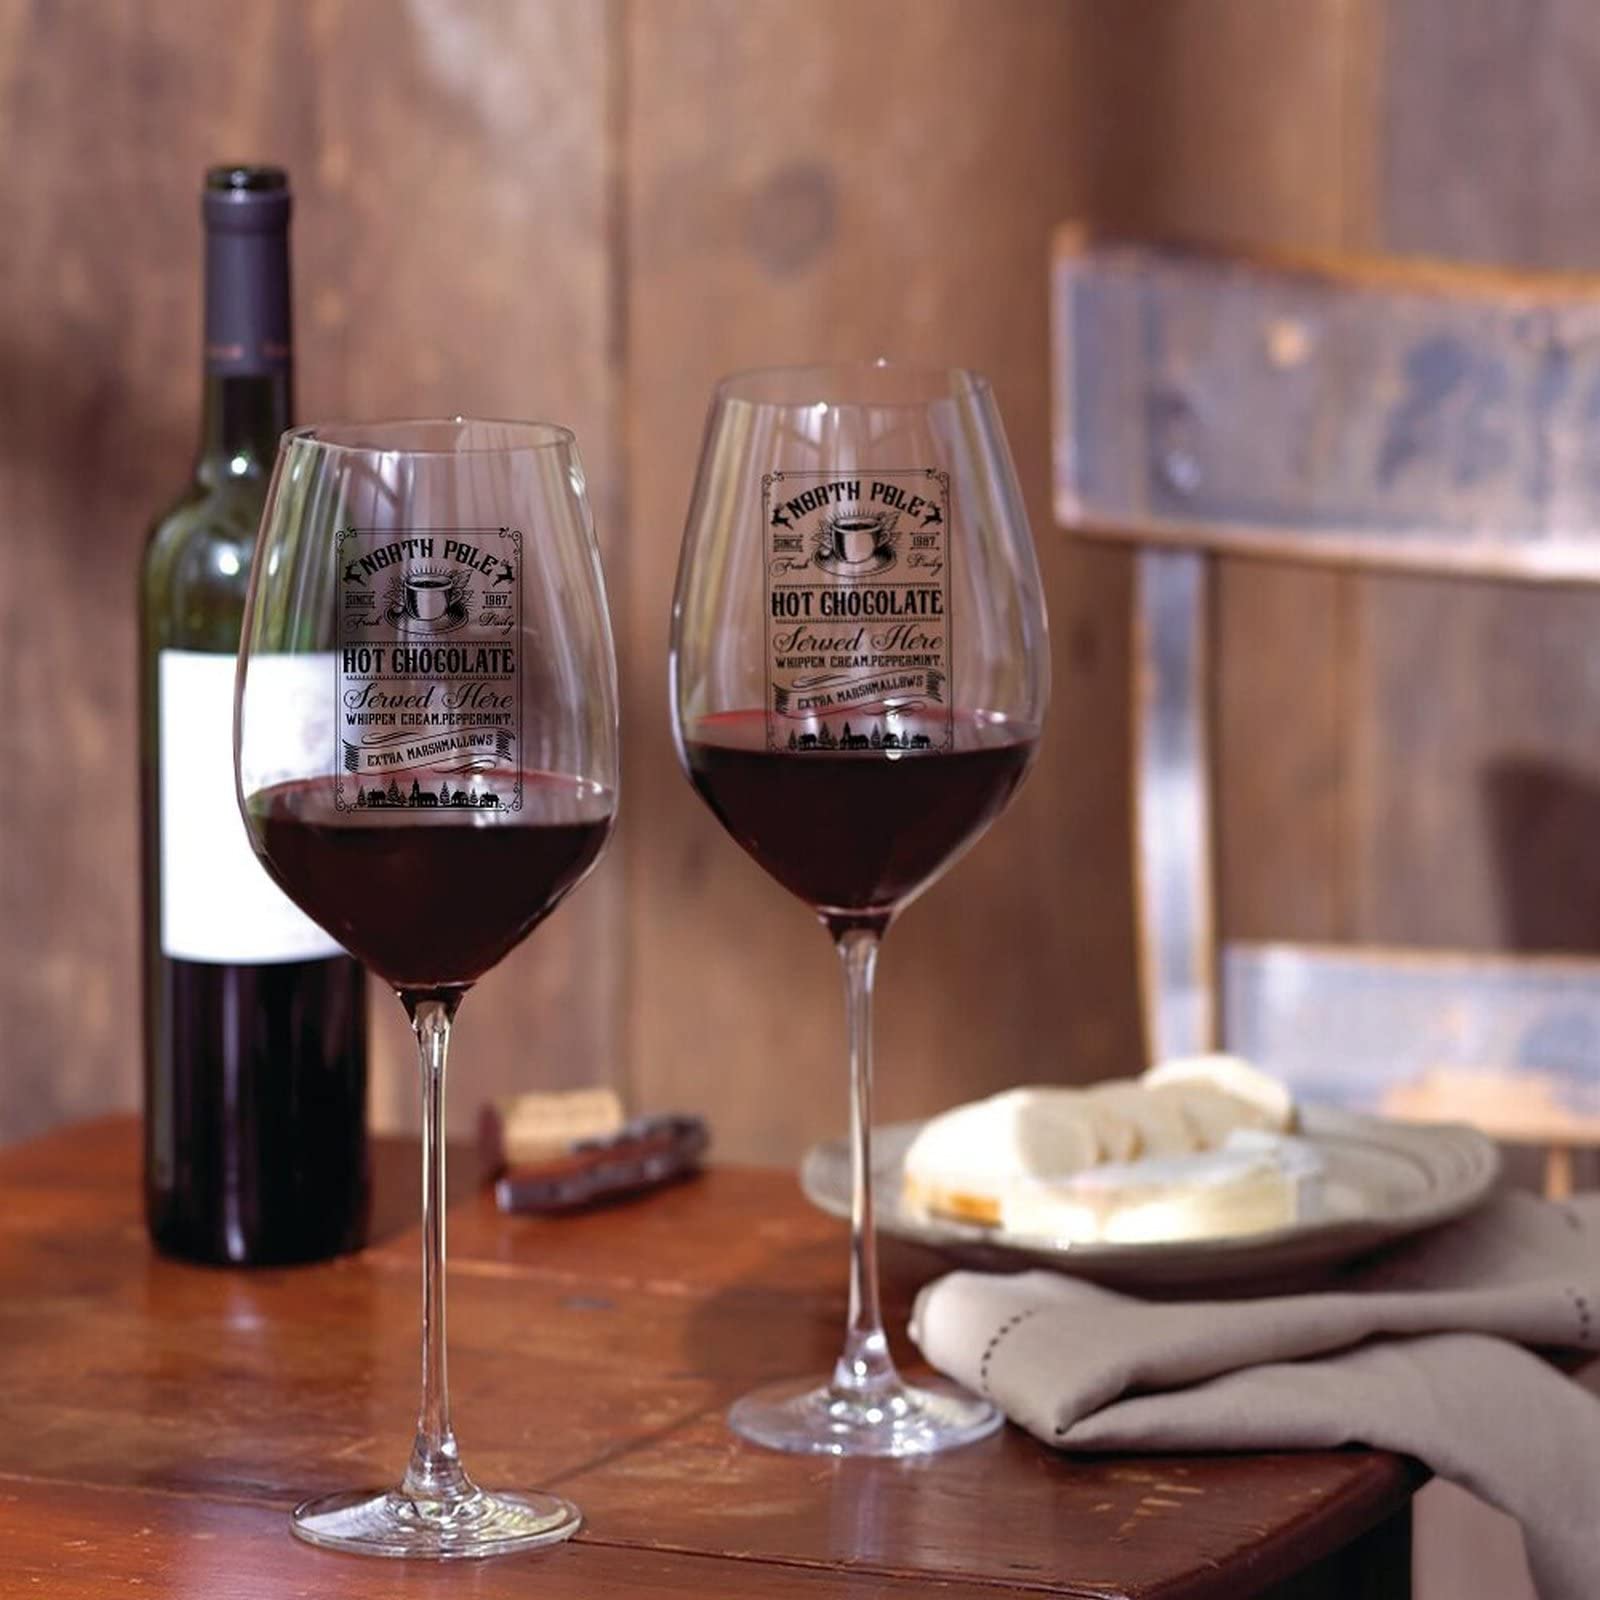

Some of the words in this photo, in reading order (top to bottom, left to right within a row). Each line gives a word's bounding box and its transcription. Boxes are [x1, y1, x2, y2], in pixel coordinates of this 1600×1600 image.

[786, 481, 860, 520] NORTH
[870, 482, 927, 518] POLE
[912, 536, 936, 547] 1987
[359, 538, 434, 576] NORTH
[443, 540, 499, 576] POLE
[346, 594, 375, 605] SINCE
[485, 595, 508, 606] 1987
[772, 591, 815, 616] HOT
[820, 590, 943, 616] CHOCOLATE
[479, 612, 515, 635] Daily
[773, 625, 865, 653] Served
[870, 624, 943, 652] Here
[343, 648, 386, 673] HOT
[392, 648, 515, 673] CHOCOLATE
[343, 683, 435, 710] Served
[442, 682, 513, 710] Here
[797, 697, 834, 711] EXTRA
[836, 675, 924, 702] MARSHMALLOWS
[367, 753, 404, 767] EXTRA
[406, 734, 494, 762] MARSHMALLOWS
